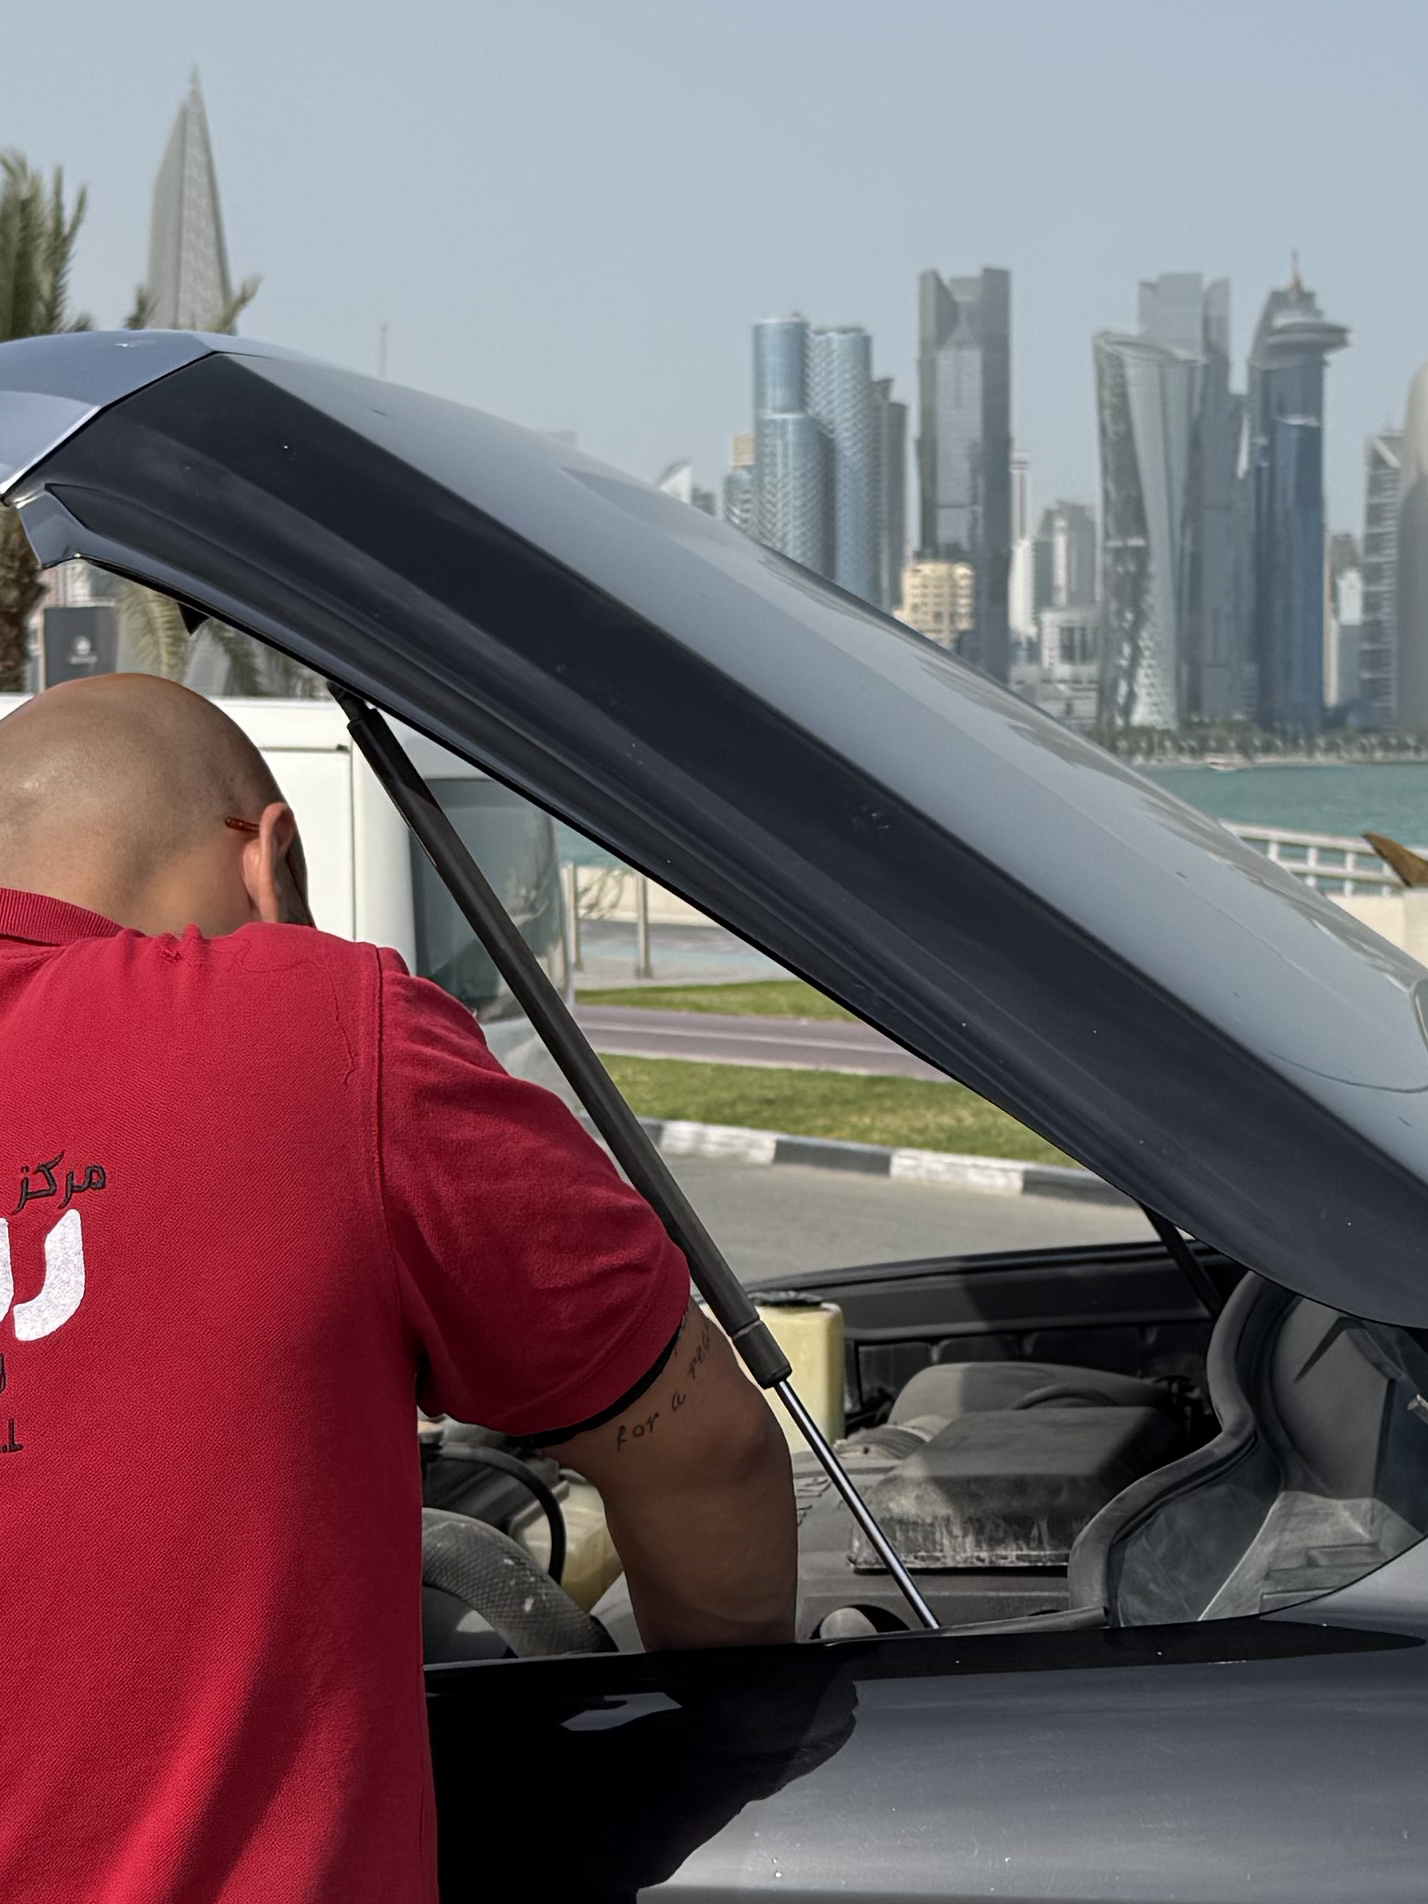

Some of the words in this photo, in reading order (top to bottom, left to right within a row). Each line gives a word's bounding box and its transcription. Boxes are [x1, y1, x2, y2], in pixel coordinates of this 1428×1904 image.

[13, 1151, 107, 1214] مركز
[615, 1411, 660, 1452] for
[670, 1389, 687, 1413] a
